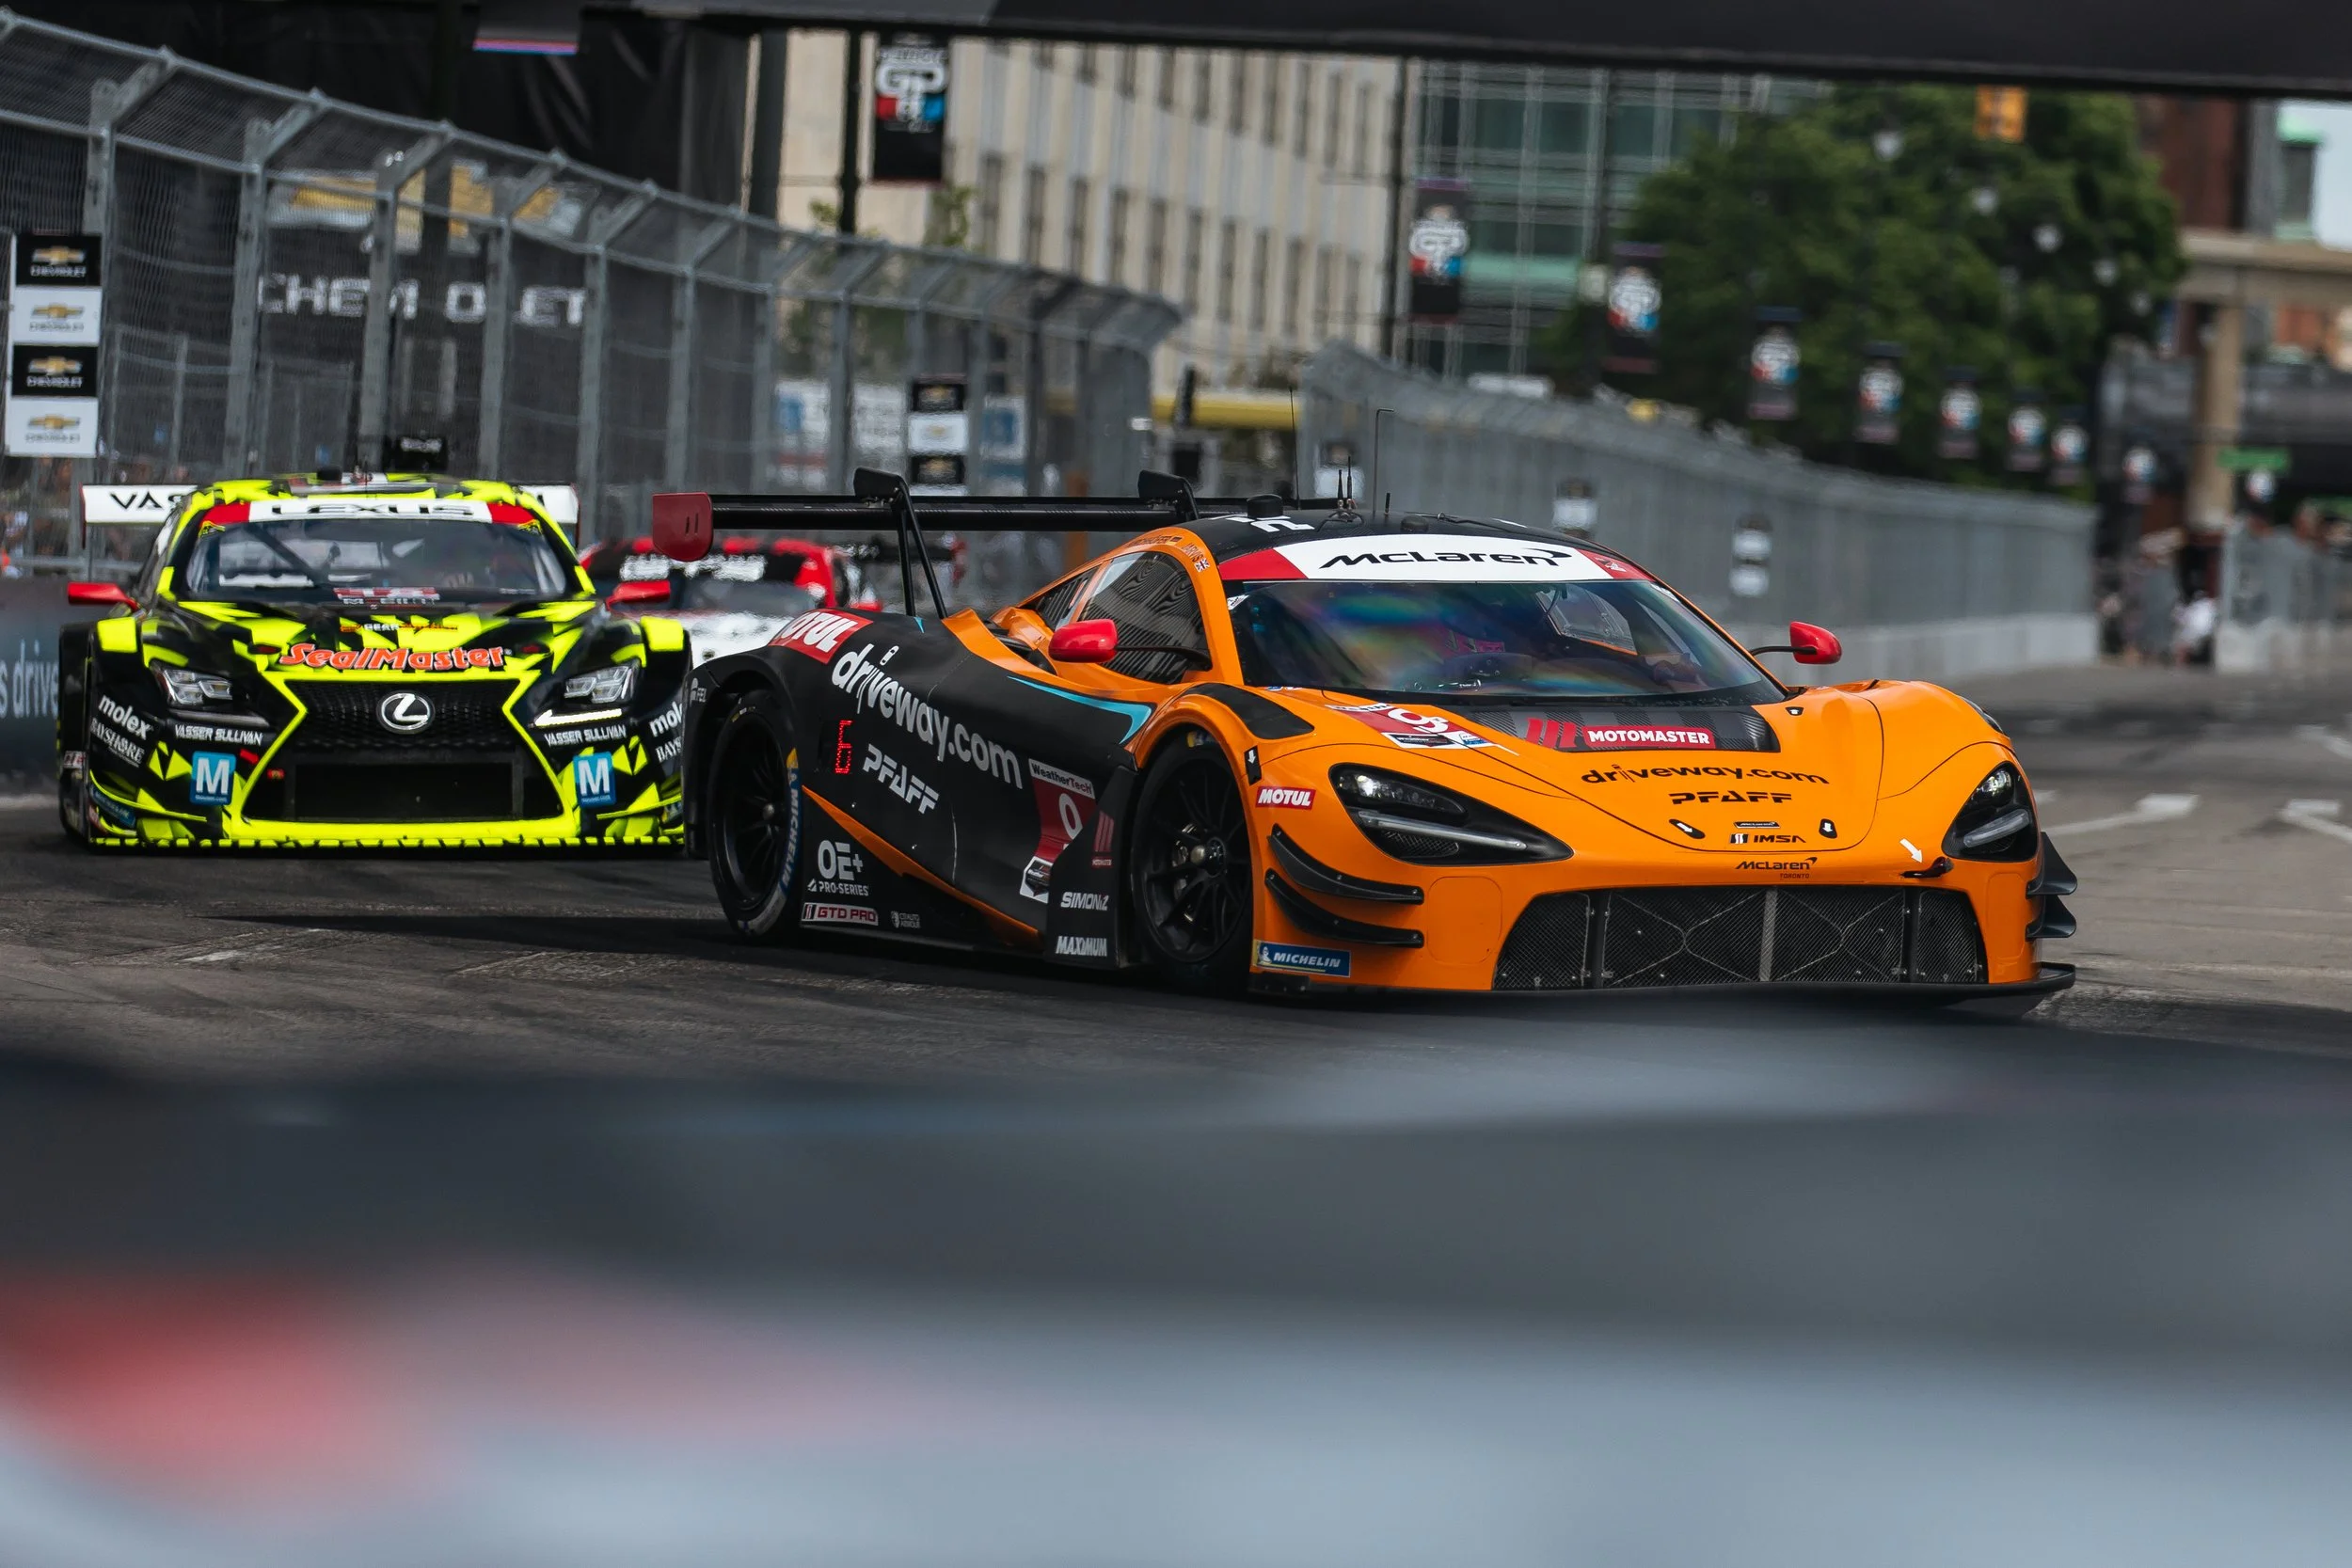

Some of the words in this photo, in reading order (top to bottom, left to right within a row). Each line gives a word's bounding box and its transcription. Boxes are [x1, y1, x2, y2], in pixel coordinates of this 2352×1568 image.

[271, 503, 474, 516] LEXUS
[1319, 550, 1561, 569] McLaren
[775, 611, 859, 653] OTUL
[279, 642, 506, 671] SealMaster
[98, 694, 151, 741] molex
[832, 643, 1023, 790] driveway.com
[175, 724, 214, 741] VASSER
[215, 728, 263, 746] SULLIVAN
[544, 728, 583, 748] VASSER
[583, 723, 627, 744] SULLIVAN
[1587, 729, 1710, 746] MOTOMASTER
[196, 757, 232, 796] M
[578, 757, 611, 796] M
[862, 743, 940, 815] PFAFF
[1031, 762, 1093, 796] WeatherTech
[1581, 764, 1830, 784] driveway.com
[1257, 788, 1311, 807] MOTUL
[1668, 790, 1792, 805] PFAFF
[1753, 834, 1806, 844] IMSA
[1735, 860, 1810, 870] McLaren
[818, 881, 869, 896] PRO-SERIES
[817, 906, 848, 920] GTD
[850, 908, 877, 923] PRO
[1273, 952, 1342, 968] MICHELIN
